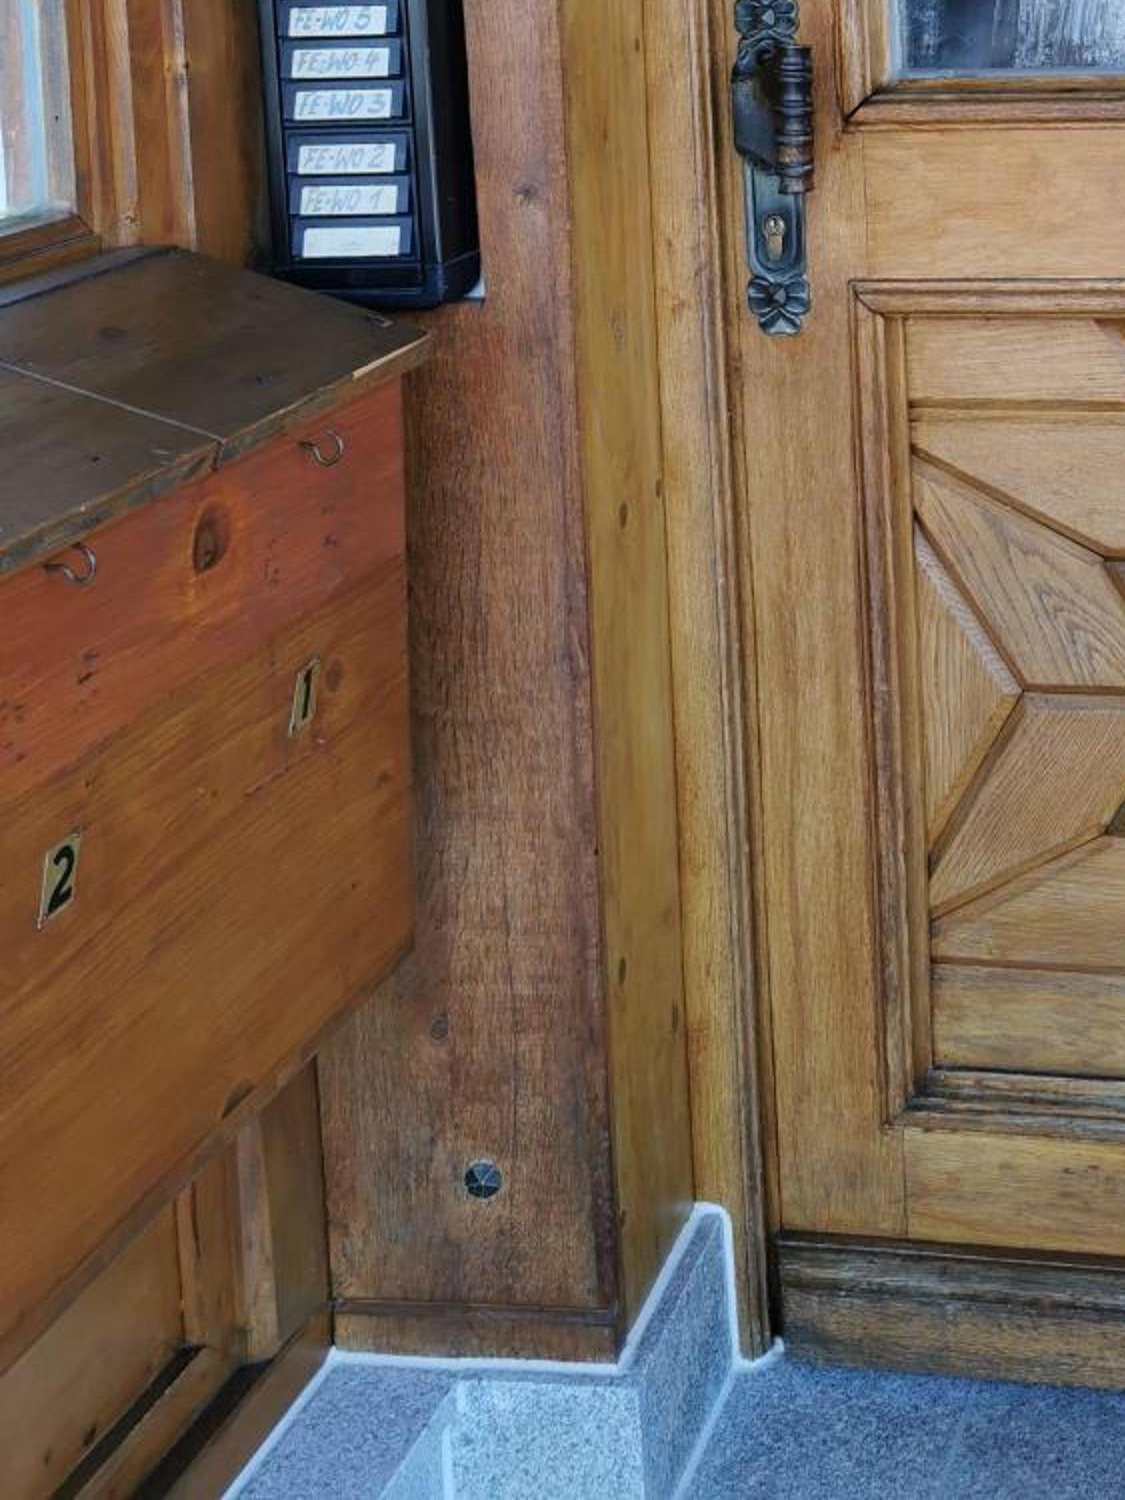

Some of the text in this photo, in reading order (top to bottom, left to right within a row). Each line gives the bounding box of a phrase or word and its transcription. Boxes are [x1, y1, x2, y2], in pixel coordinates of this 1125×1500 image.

[368, 145, 386, 169] 2
[301, 670, 313, 719] 1
[46, 844, 75, 916] 2
